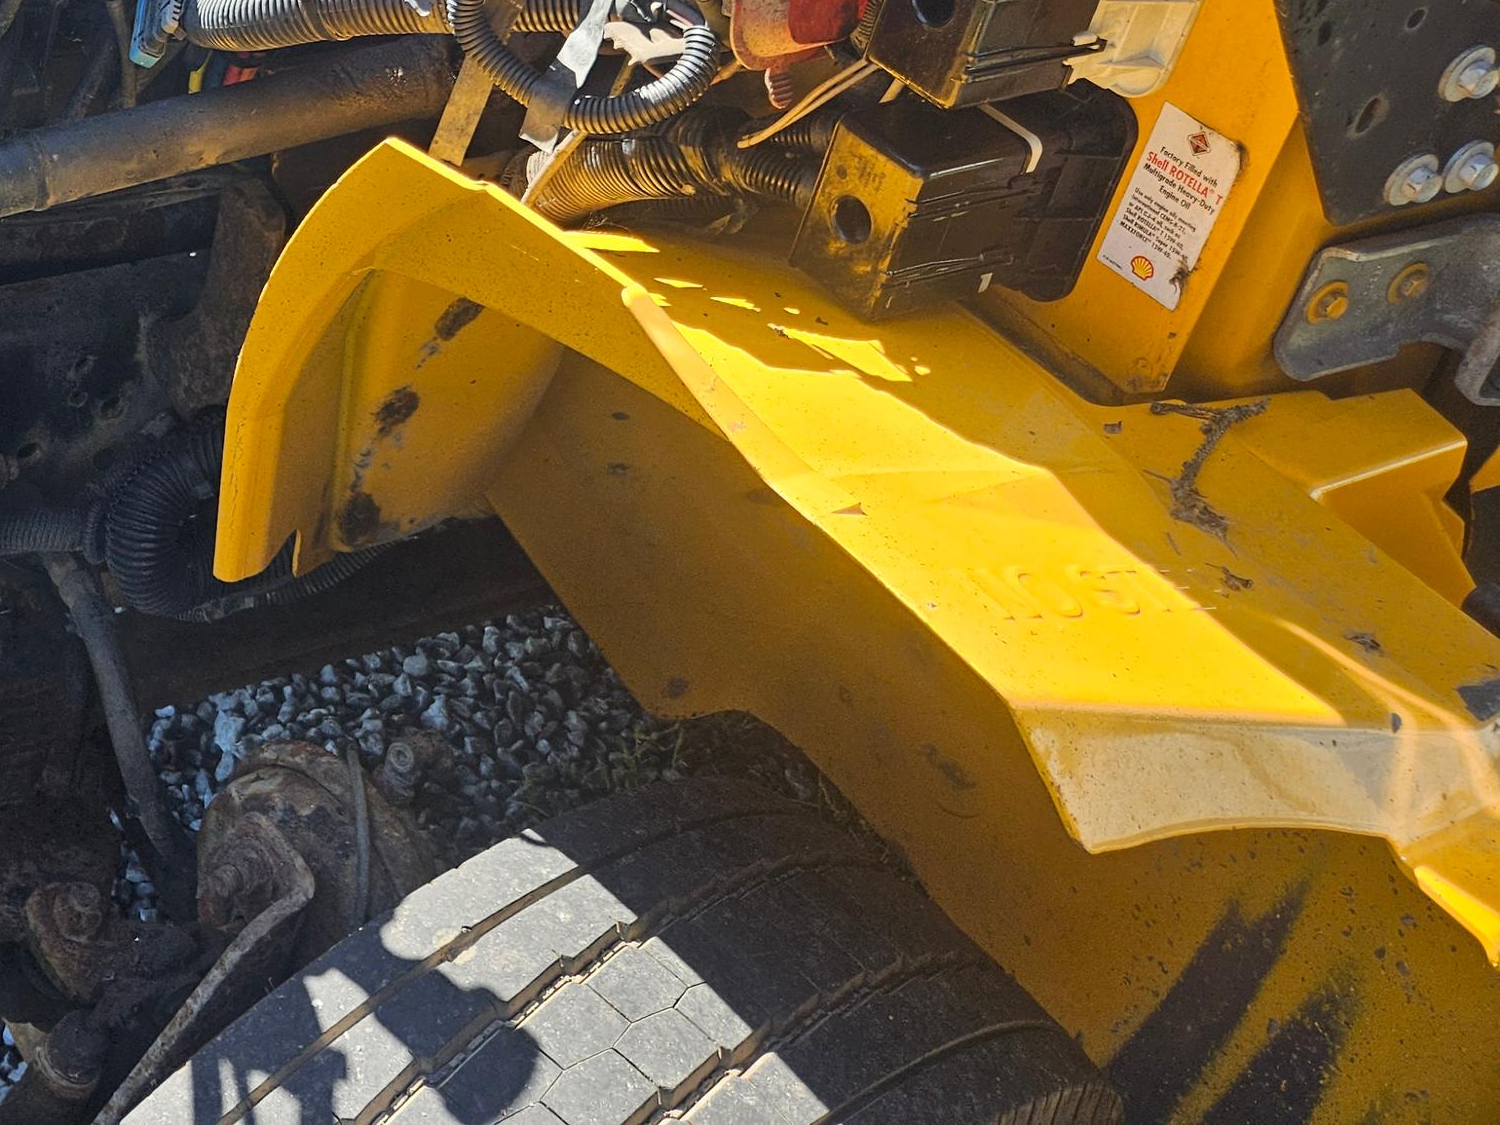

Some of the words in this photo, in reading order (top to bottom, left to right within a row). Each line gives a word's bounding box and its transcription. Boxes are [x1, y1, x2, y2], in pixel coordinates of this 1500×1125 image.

[1143, 162, 1176, 188] Multigrade
[1177, 185, 1215, 215] Heavy-Duty
[1147, 151, 1169, 171] Shell
[1215, 194, 1223, 205] T
[1160, 146, 1184, 166] Factory
[1184, 162, 1202, 177] Filled
[1203, 175, 1218, 187] with
[1159, 185, 1180, 203] Engine
[1180, 199, 1191, 210] Oil
